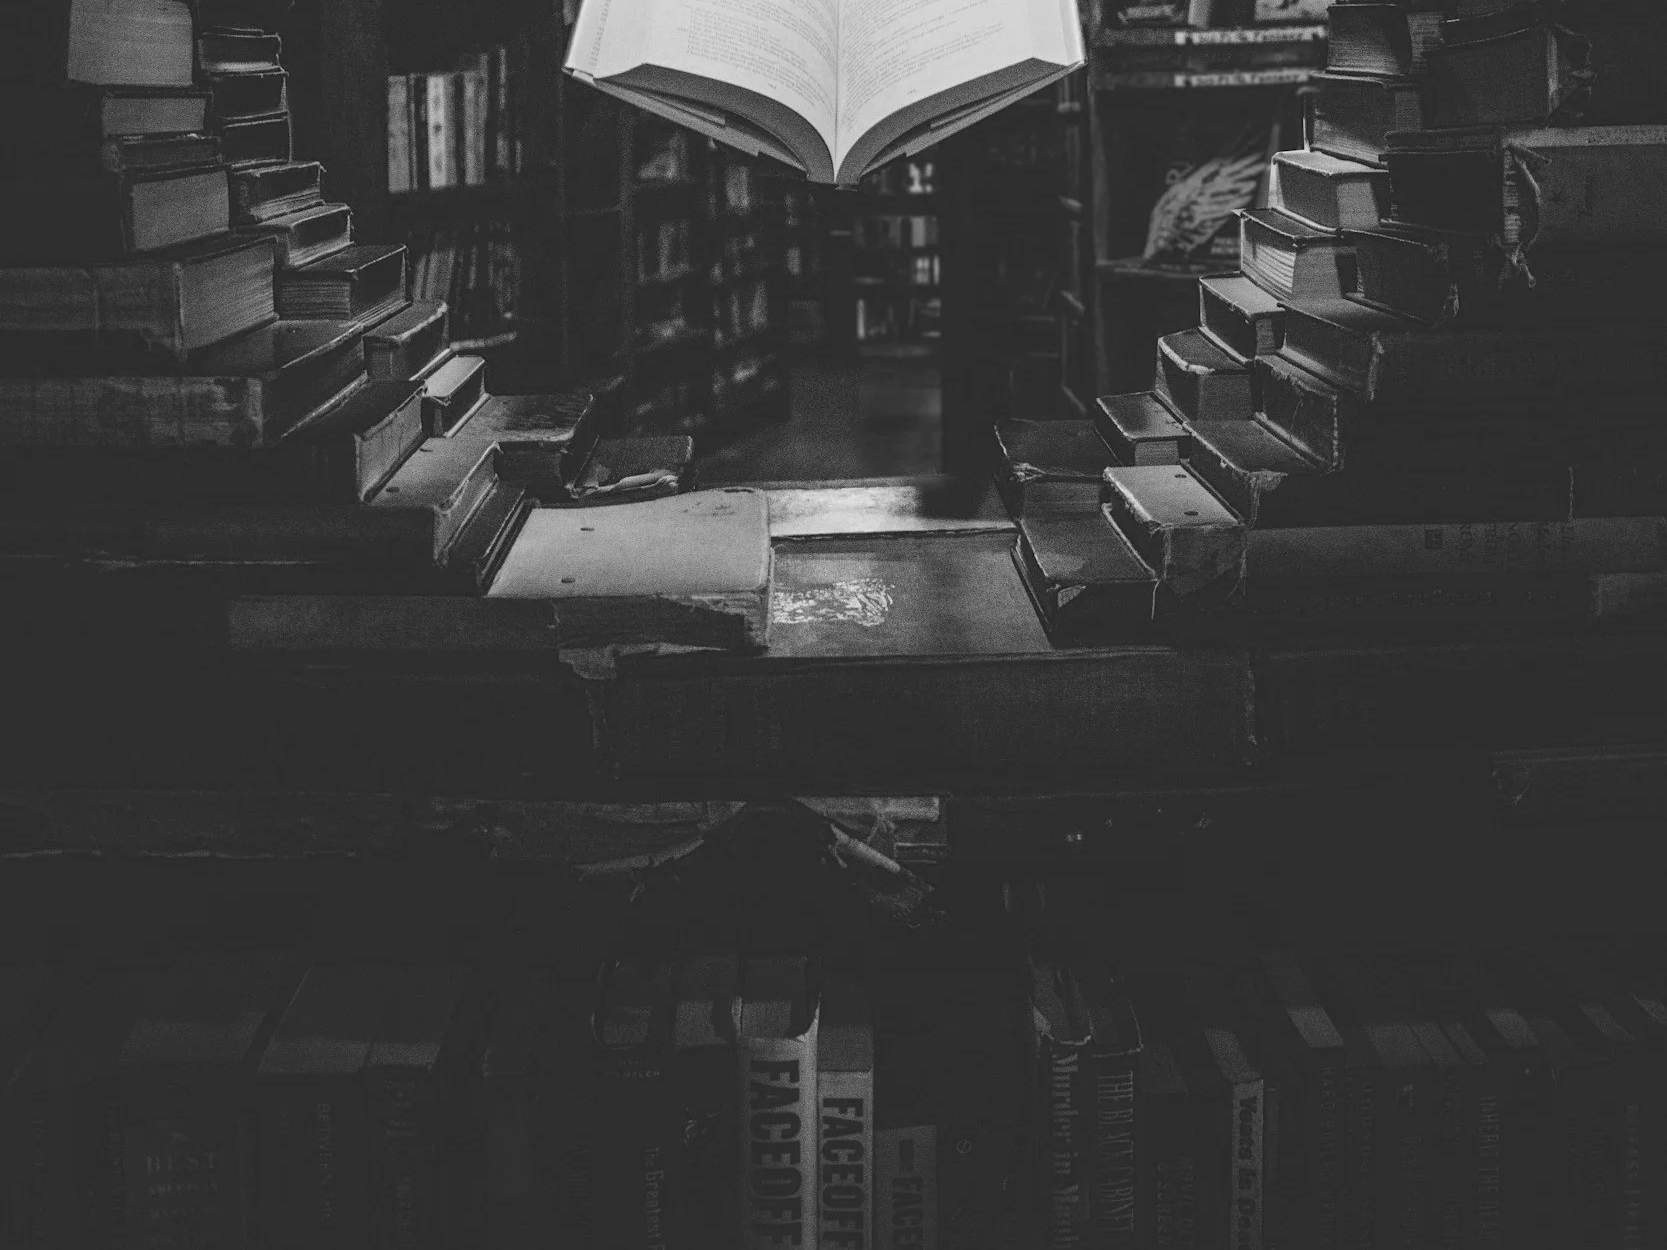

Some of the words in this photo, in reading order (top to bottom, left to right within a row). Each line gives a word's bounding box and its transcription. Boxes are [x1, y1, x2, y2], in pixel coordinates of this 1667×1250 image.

[1051, 1052, 1079, 1144] Murder
[1096, 1069, 1134, 1104] THE
[749, 1059, 802, 1246] FACEOFF
[1096, 1108, 1134, 1161] BLACK
[1238, 1095, 1258, 1161] Yeats
[821, 1097, 865, 1250] FACEOFF
[1051, 1151, 1079, 1176] in
[1238, 1168, 1257, 1190] Is
[643, 1169, 665, 1239] Greatest
